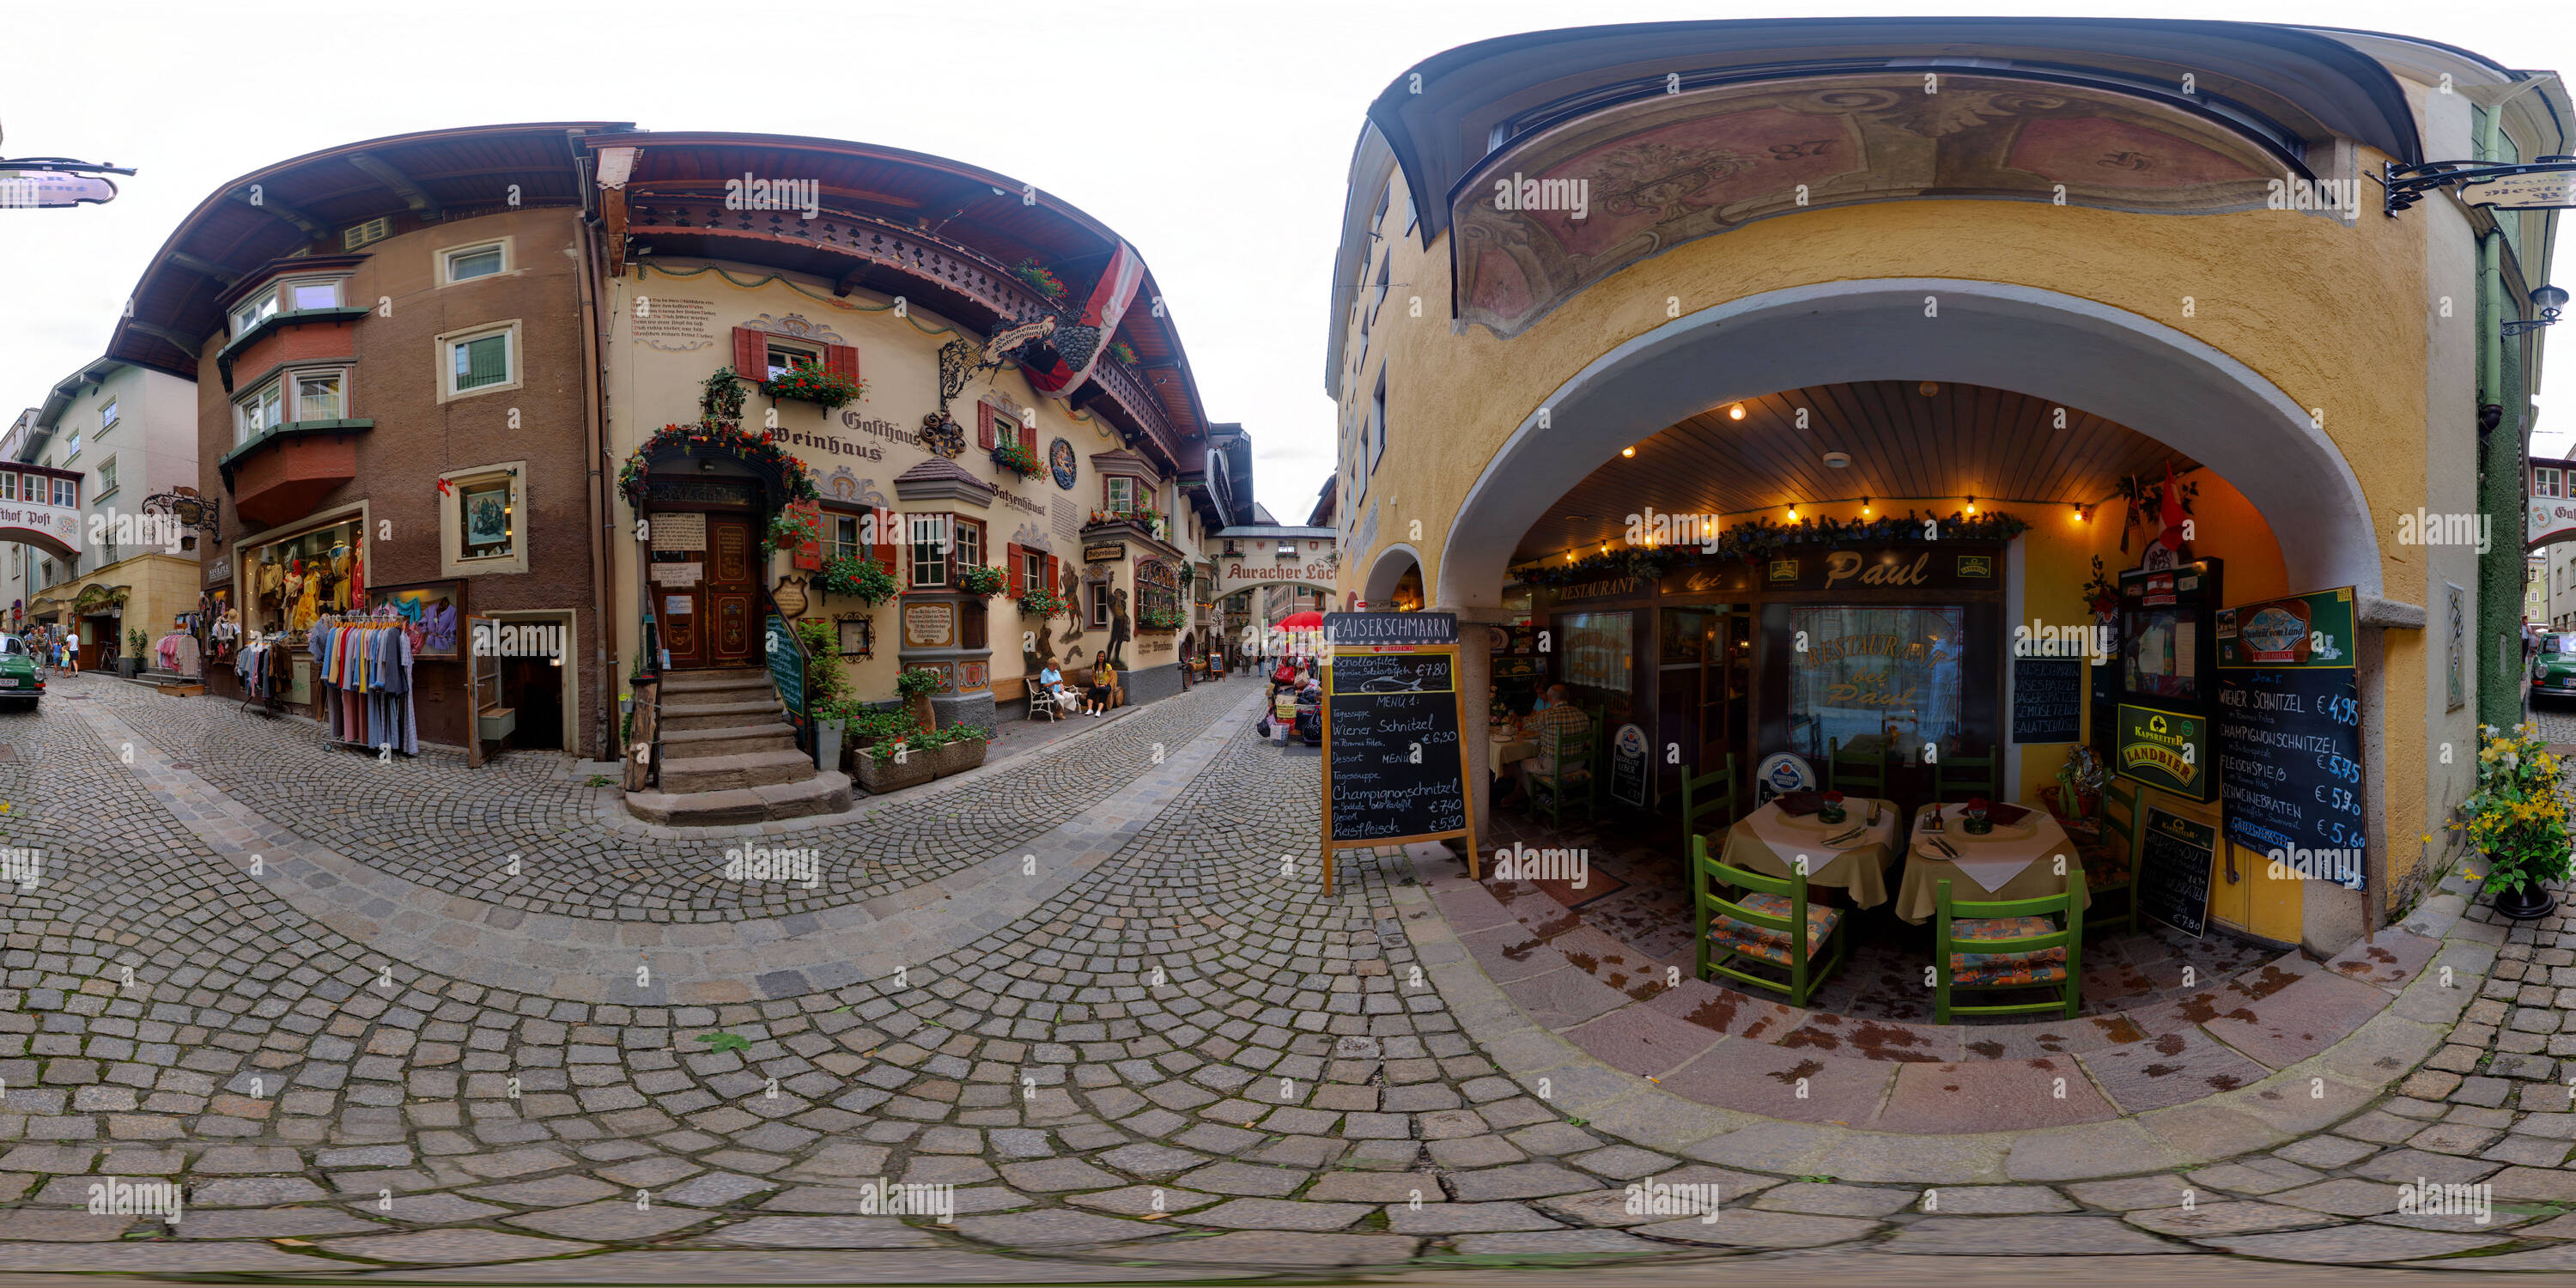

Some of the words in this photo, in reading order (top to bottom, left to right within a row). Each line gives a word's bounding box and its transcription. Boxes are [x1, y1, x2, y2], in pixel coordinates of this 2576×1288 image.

[841, 410, 923, 450] Gasthaus
[763, 427, 886, 463] Weinhaus
[989, 482, 1046, 516] Batzenhäusl
[27, 511, 51, 526] Post
[1227, 563, 1302, 580] Auracher
[1307, 563, 1337, 580] Löc
[1686, 571, 1722, 589] bei
[1825, 550, 1929, 589] Paul
[1560, 577, 1635, 600] RESTAURANT
[1332, 618, 1450, 638] KAISERSCHMARRN
[1808, 634, 1947, 670] RESTAURANT
[1852, 666, 1888, 683] bei
[1376, 696, 1406, 708] MENÜ
[1827, 683, 1917, 706] Paul
[2219, 689, 2247, 708] WIENER
[2253, 690, 2306, 713] SCHNITZEL
[1333, 708, 1370, 723] Tagessuppe
[1333, 723, 1370, 736] Wiener
[1377, 714, 1434, 732] Schnitzel
[2135, 726, 2184, 747] KAPSREITER
[2221, 723, 2342, 756] CHAMPIGNONSCHNITZEL
[1333, 752, 1364, 764] Dessert
[2126, 747, 2191, 779] LANDBIER
[1333, 771, 1381, 785] Tagessuppe
[1333, 778, 1460, 805] Champignonschnitzel
[2222, 783, 2301, 819] SCHWEINEBRATEN
[1333, 817, 1400, 838] Reisfleisch
